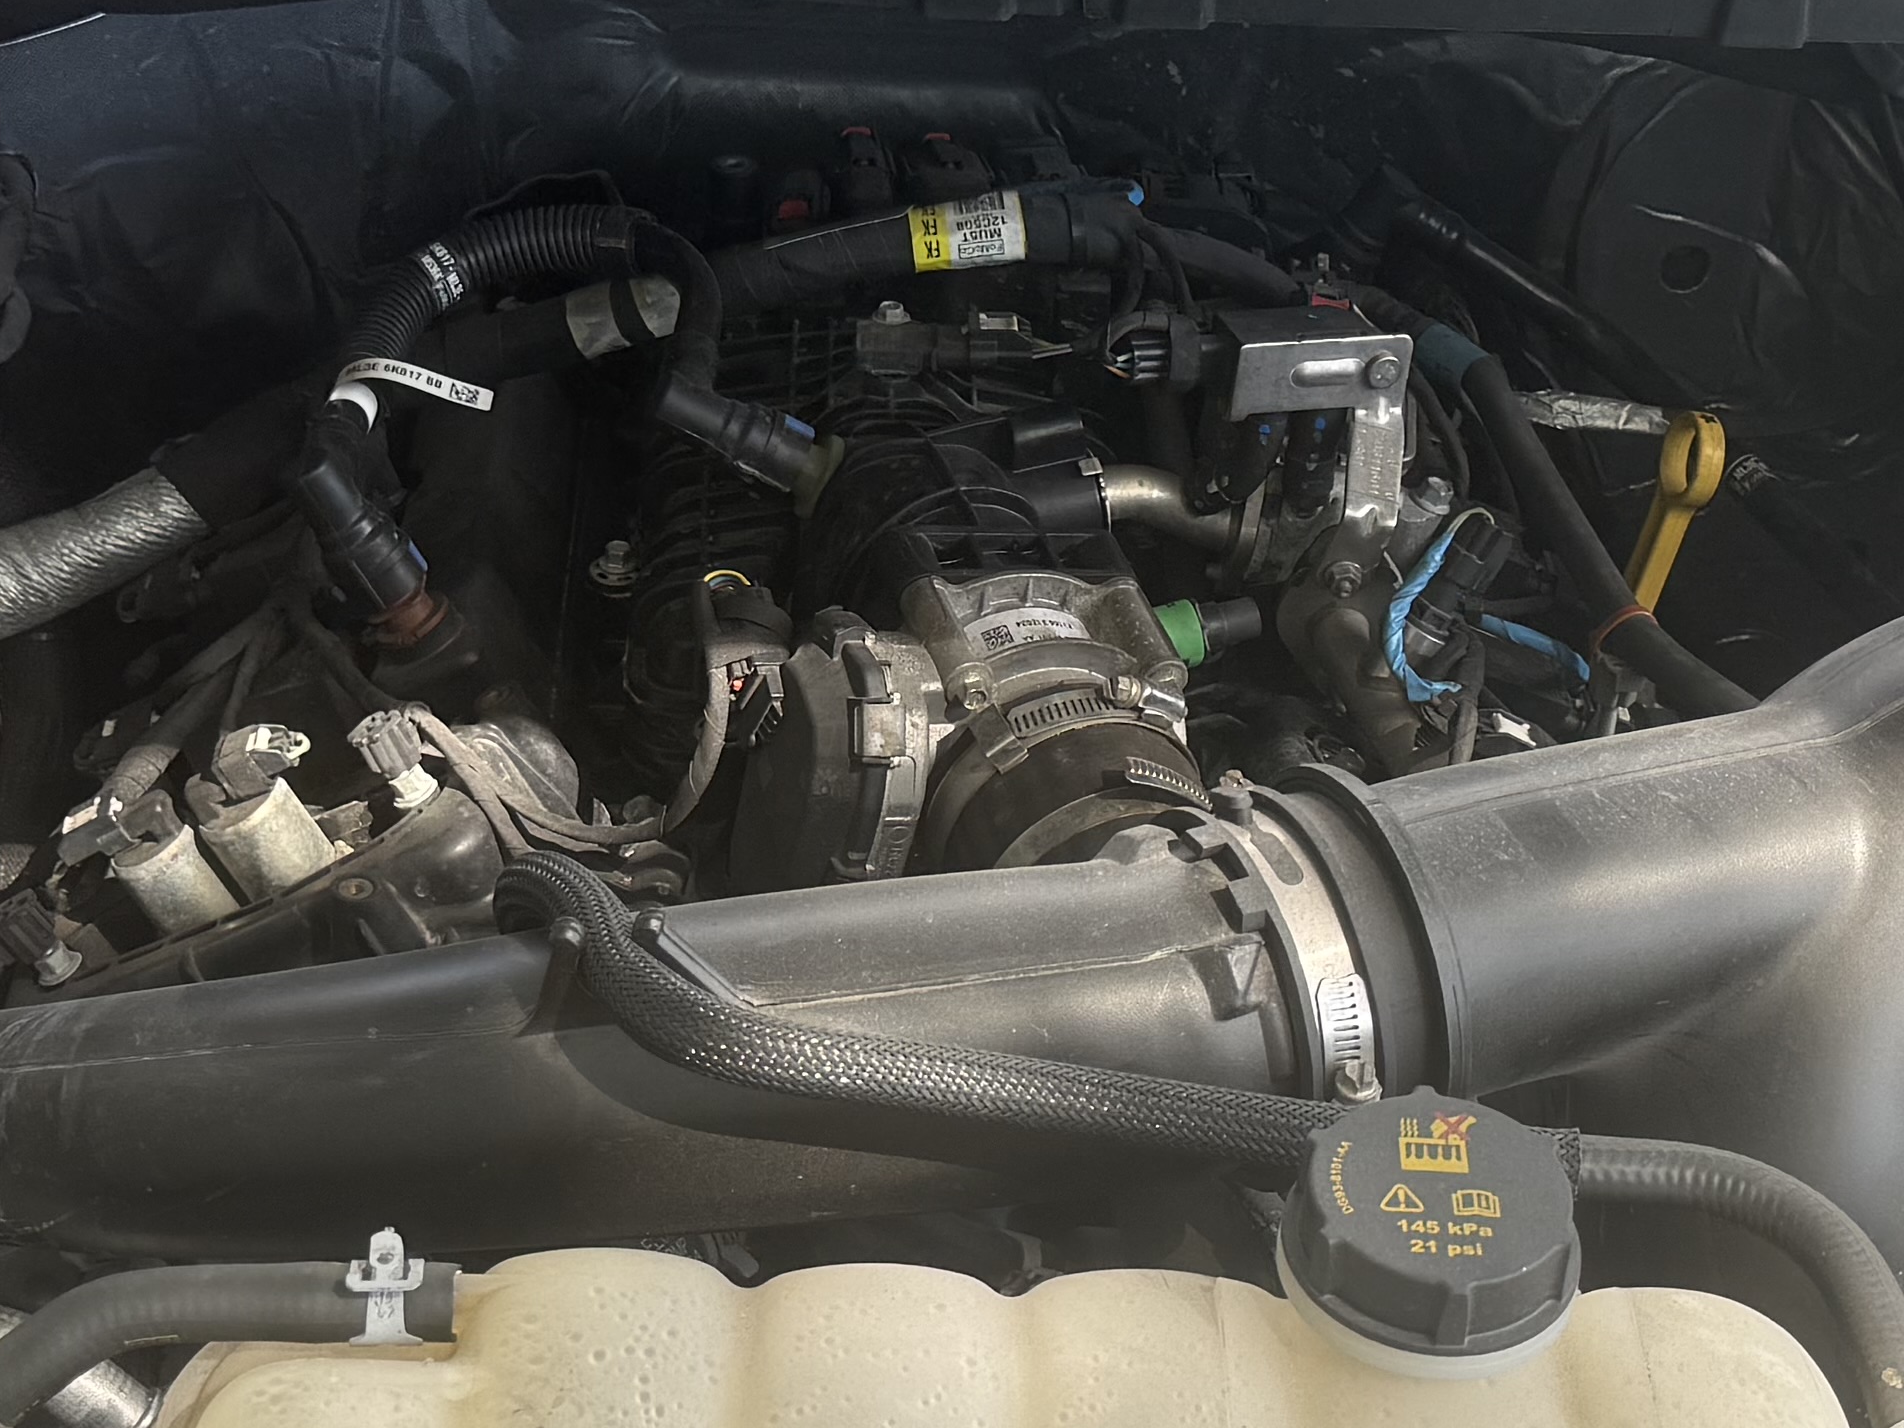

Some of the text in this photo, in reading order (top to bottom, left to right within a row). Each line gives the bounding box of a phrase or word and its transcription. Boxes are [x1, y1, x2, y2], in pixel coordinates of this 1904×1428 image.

[1397, 1220, 1494, 1238] 145 kPa
[1410, 1239, 1484, 1258] 21 psi
